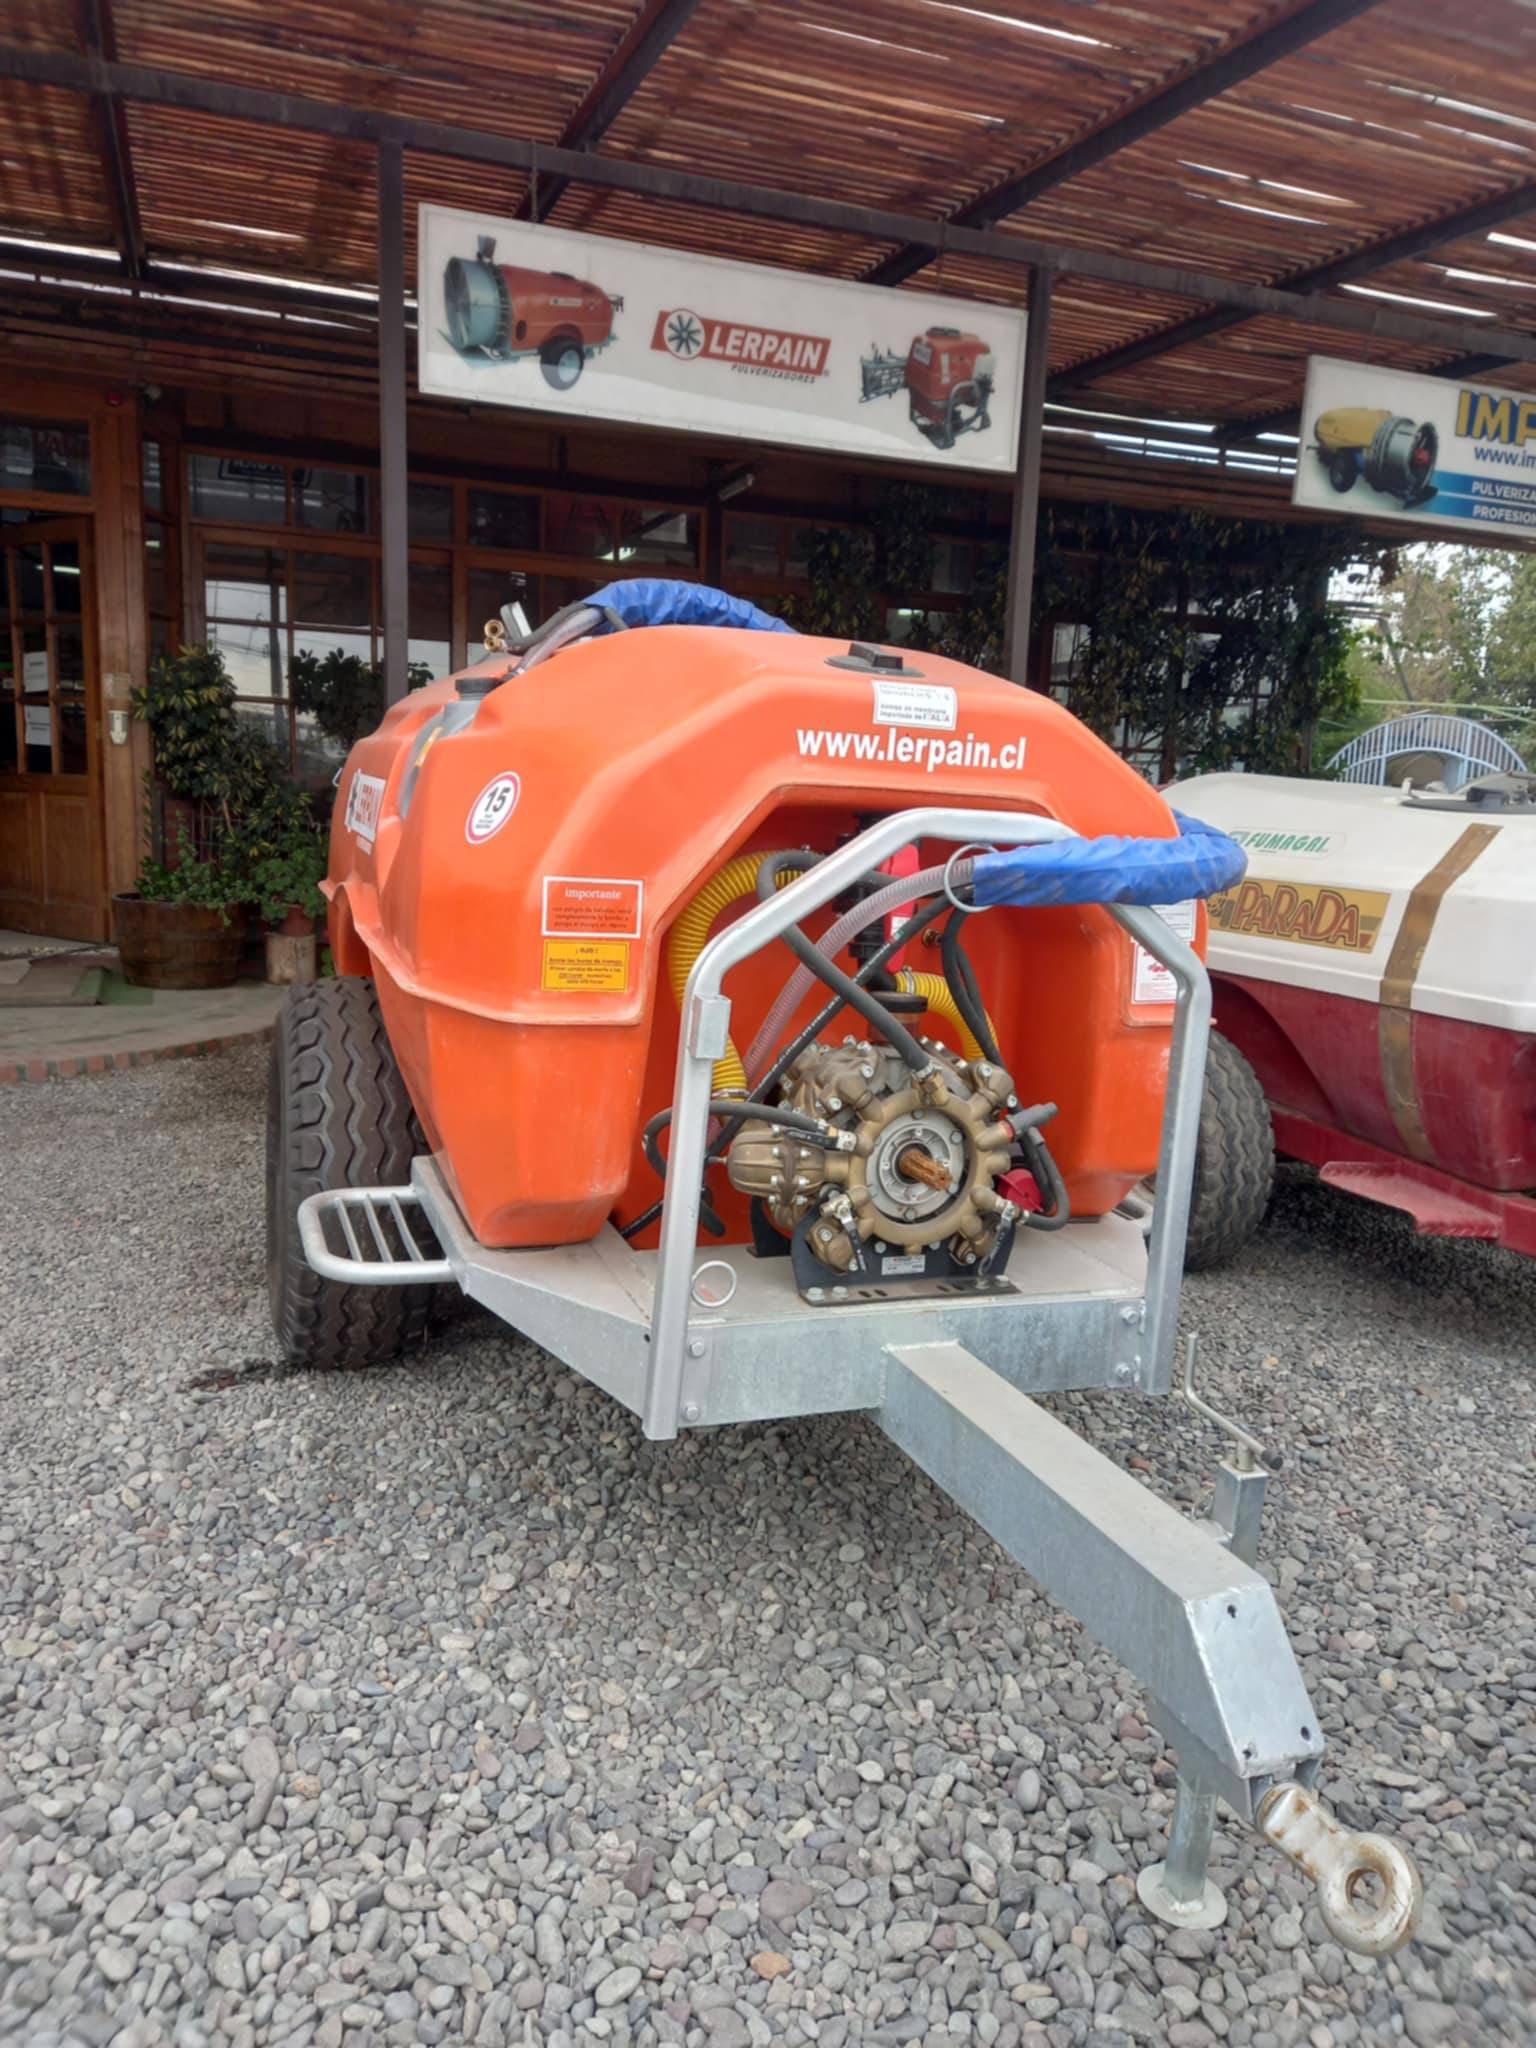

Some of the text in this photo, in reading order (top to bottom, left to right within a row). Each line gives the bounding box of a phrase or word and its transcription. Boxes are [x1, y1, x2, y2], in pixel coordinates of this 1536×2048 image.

[709, 326, 823, 370] LERPAIN
[731, 363, 816, 384] PULVERIZADORES
[796, 727, 1027, 773] www.lerpain.cl
[484, 786, 512, 812] 15
[1230, 881, 1359, 947] PARADA
